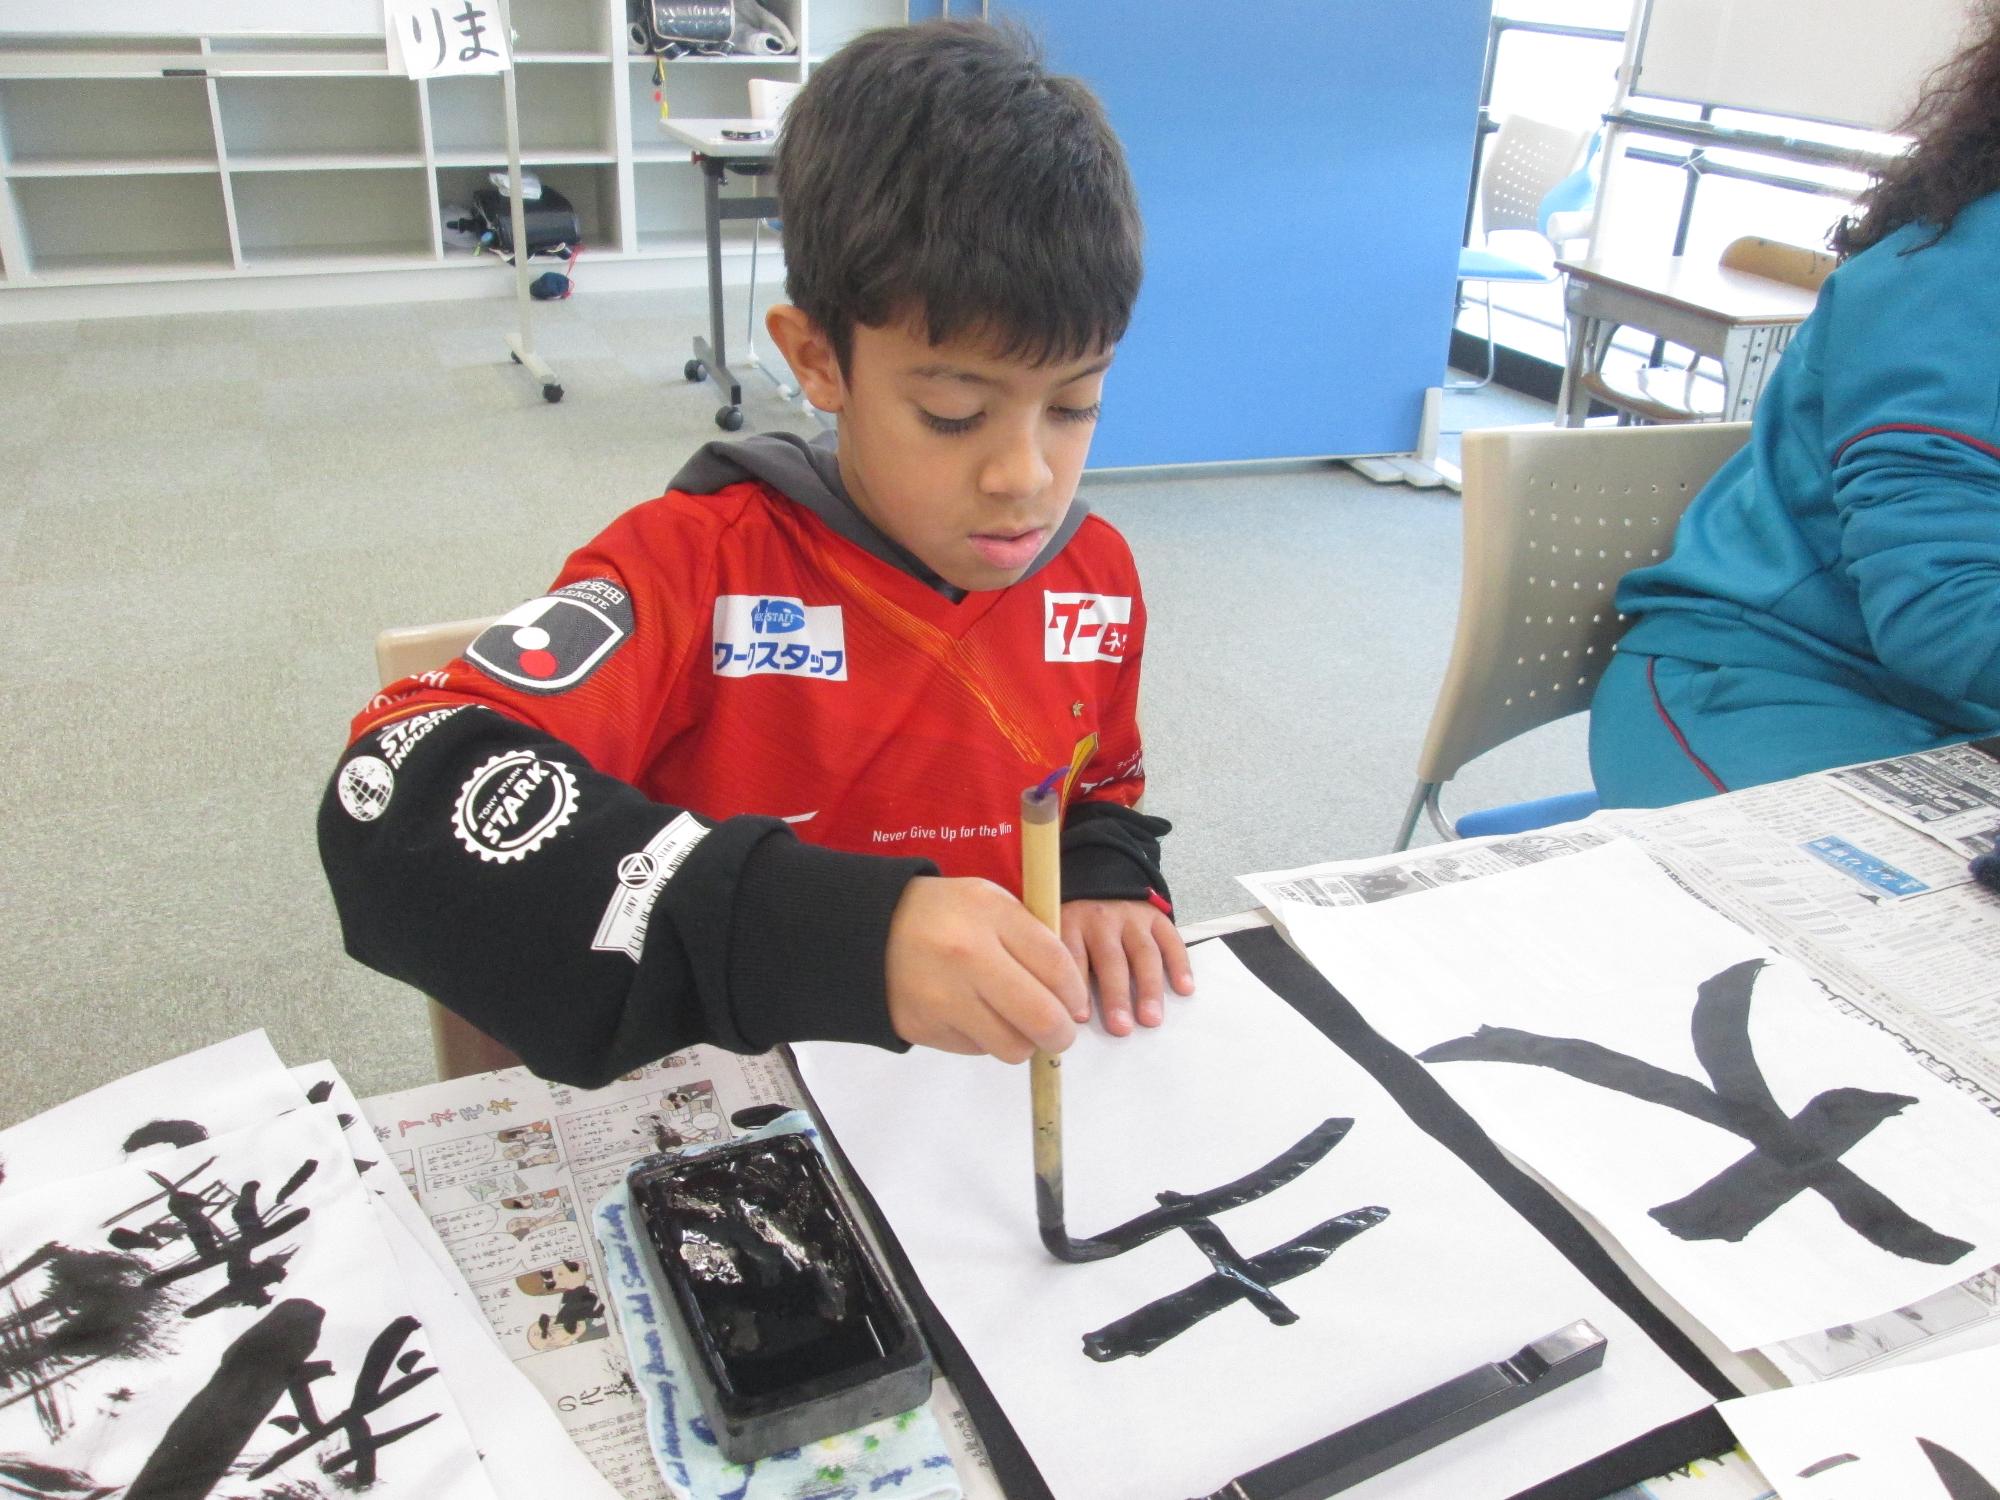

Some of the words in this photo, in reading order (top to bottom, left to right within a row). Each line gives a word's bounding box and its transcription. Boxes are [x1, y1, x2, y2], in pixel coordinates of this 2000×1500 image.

[478, 795, 499, 820] TONY
[497, 767, 523, 795] STARK
[481, 761, 550, 845] STARK
[873, 830, 907, 843] Never
[910, 826, 937, 839] Give
[940, 827, 957, 843] Up
[960, 826, 976, 838] for
[979, 825, 998, 837] the
[999, 821, 1013, 836] Win
